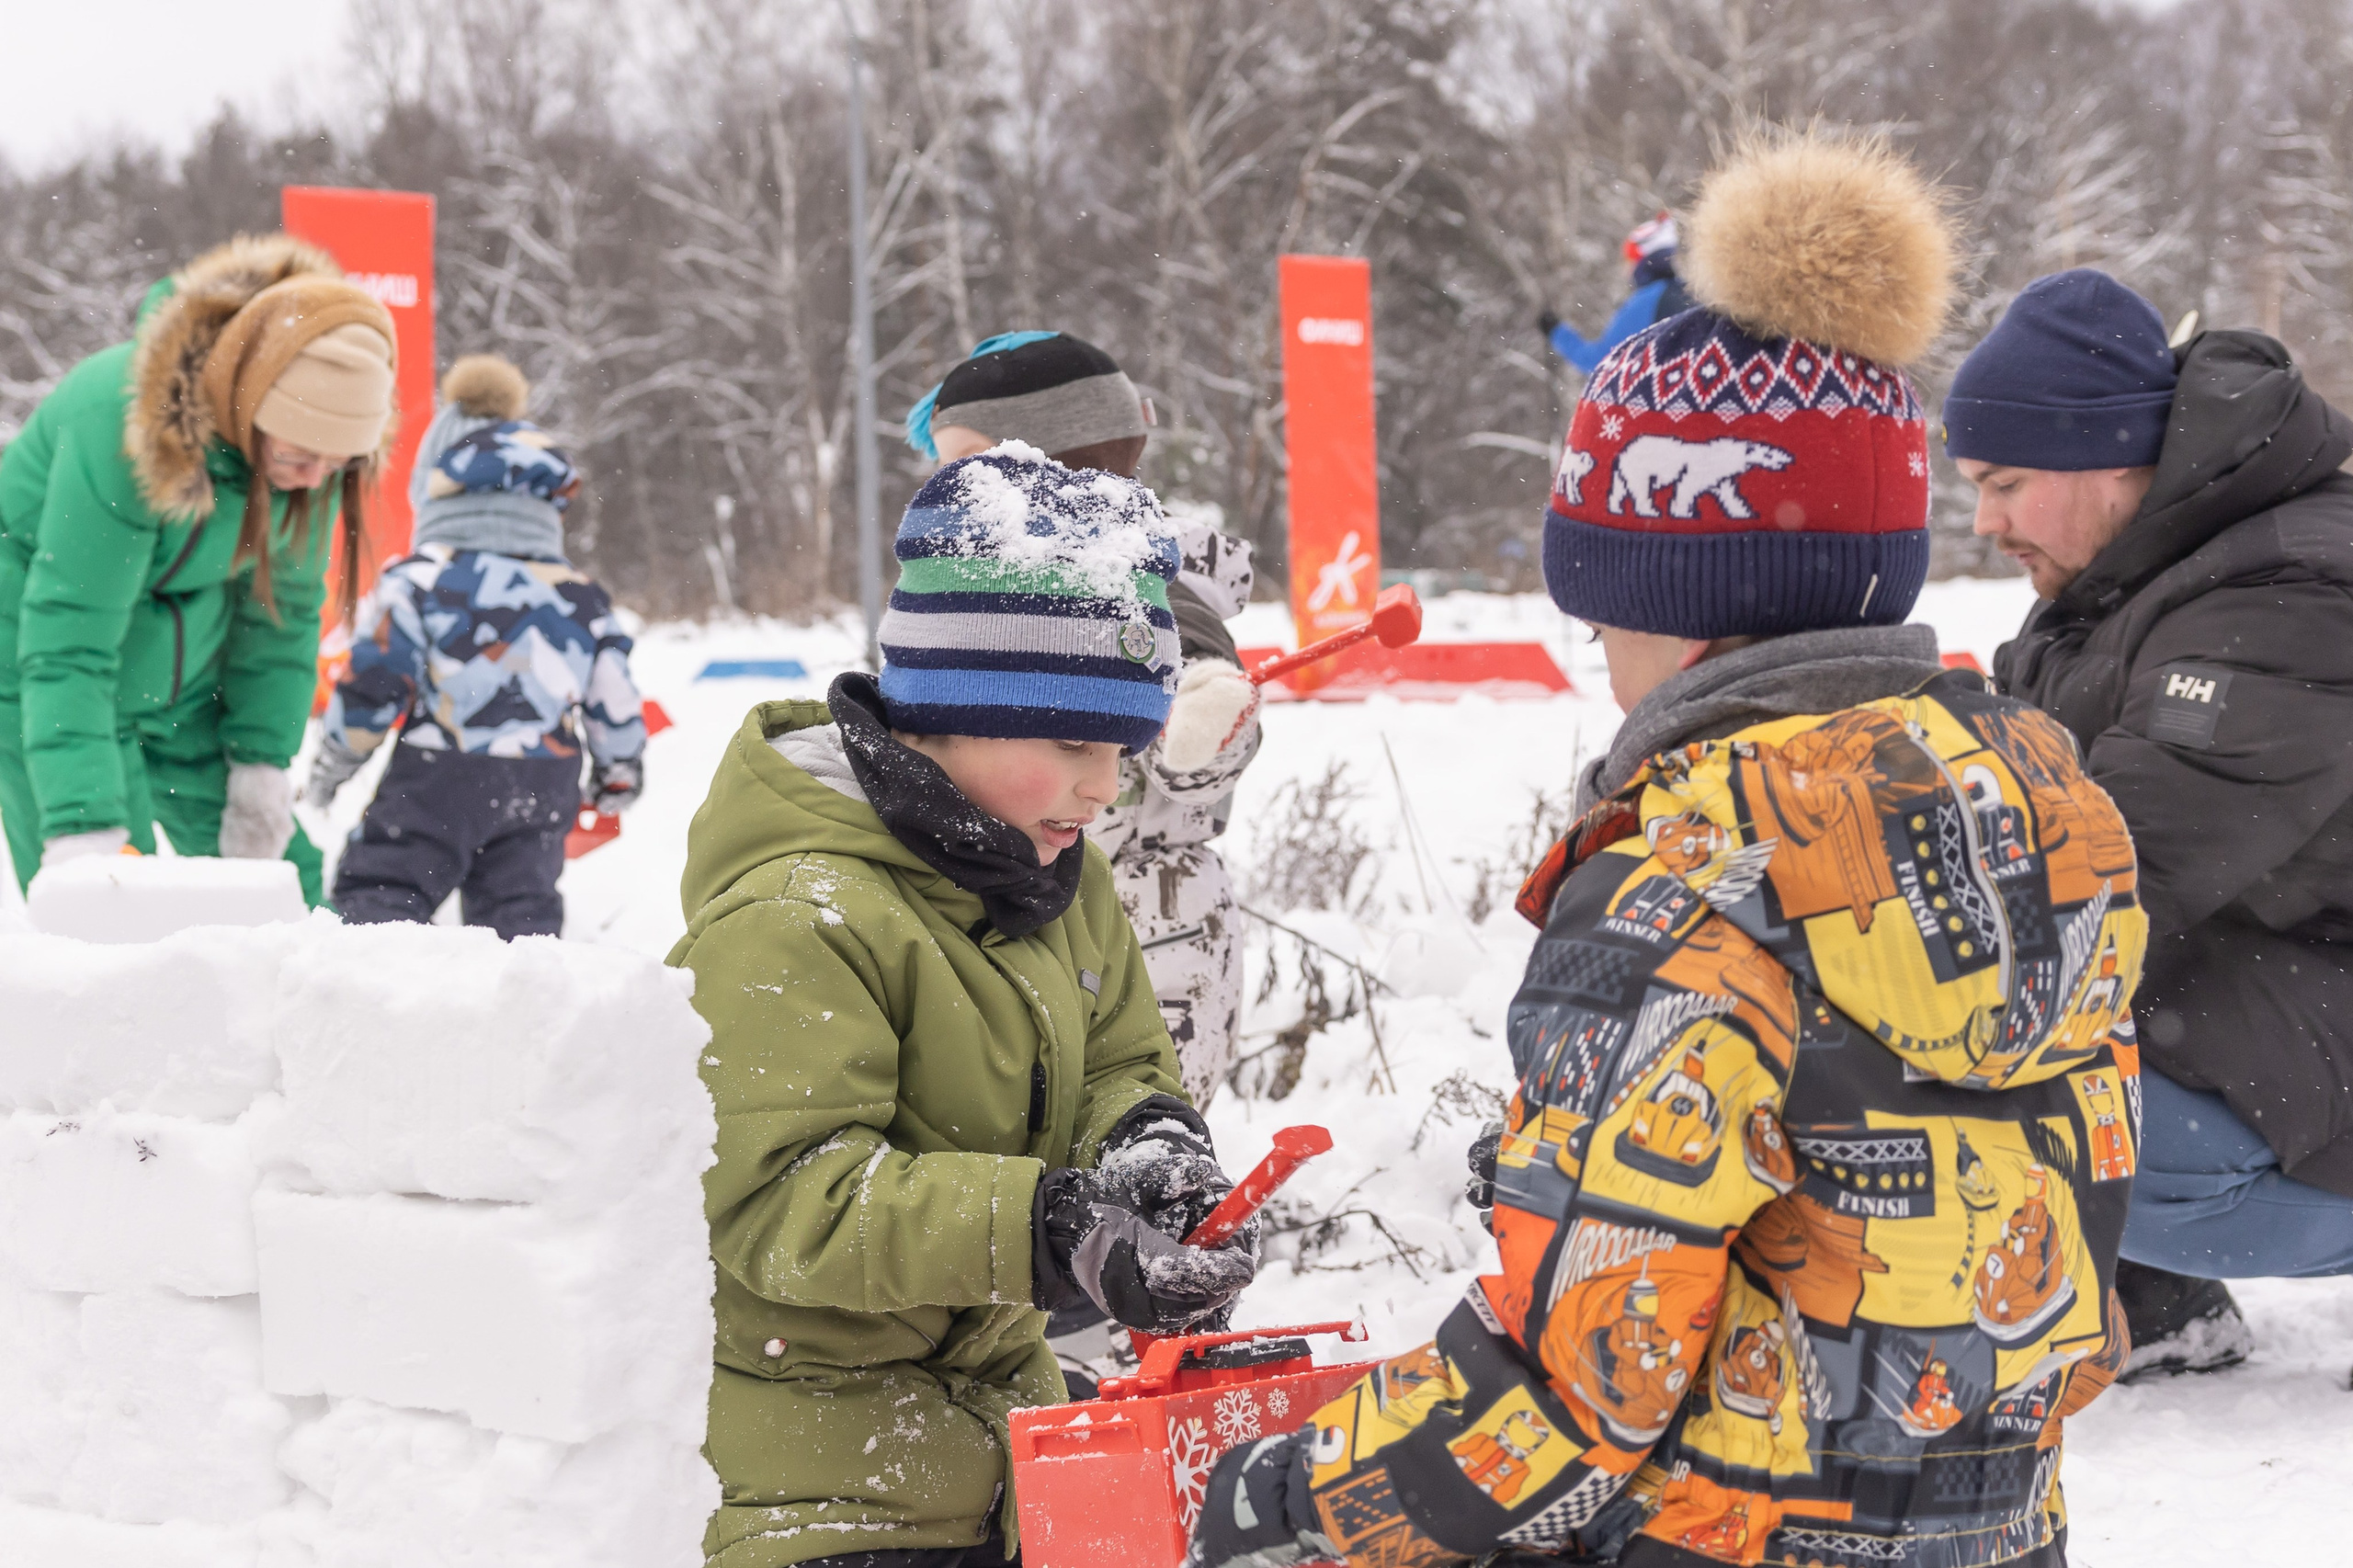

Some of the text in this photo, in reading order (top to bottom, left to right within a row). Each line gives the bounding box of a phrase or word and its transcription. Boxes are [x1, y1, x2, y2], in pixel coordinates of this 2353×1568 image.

[2165, 673, 2217, 704] HH
[1896, 859, 1941, 937] FINISH
[1837, 1190, 1910, 1218] FINISH
